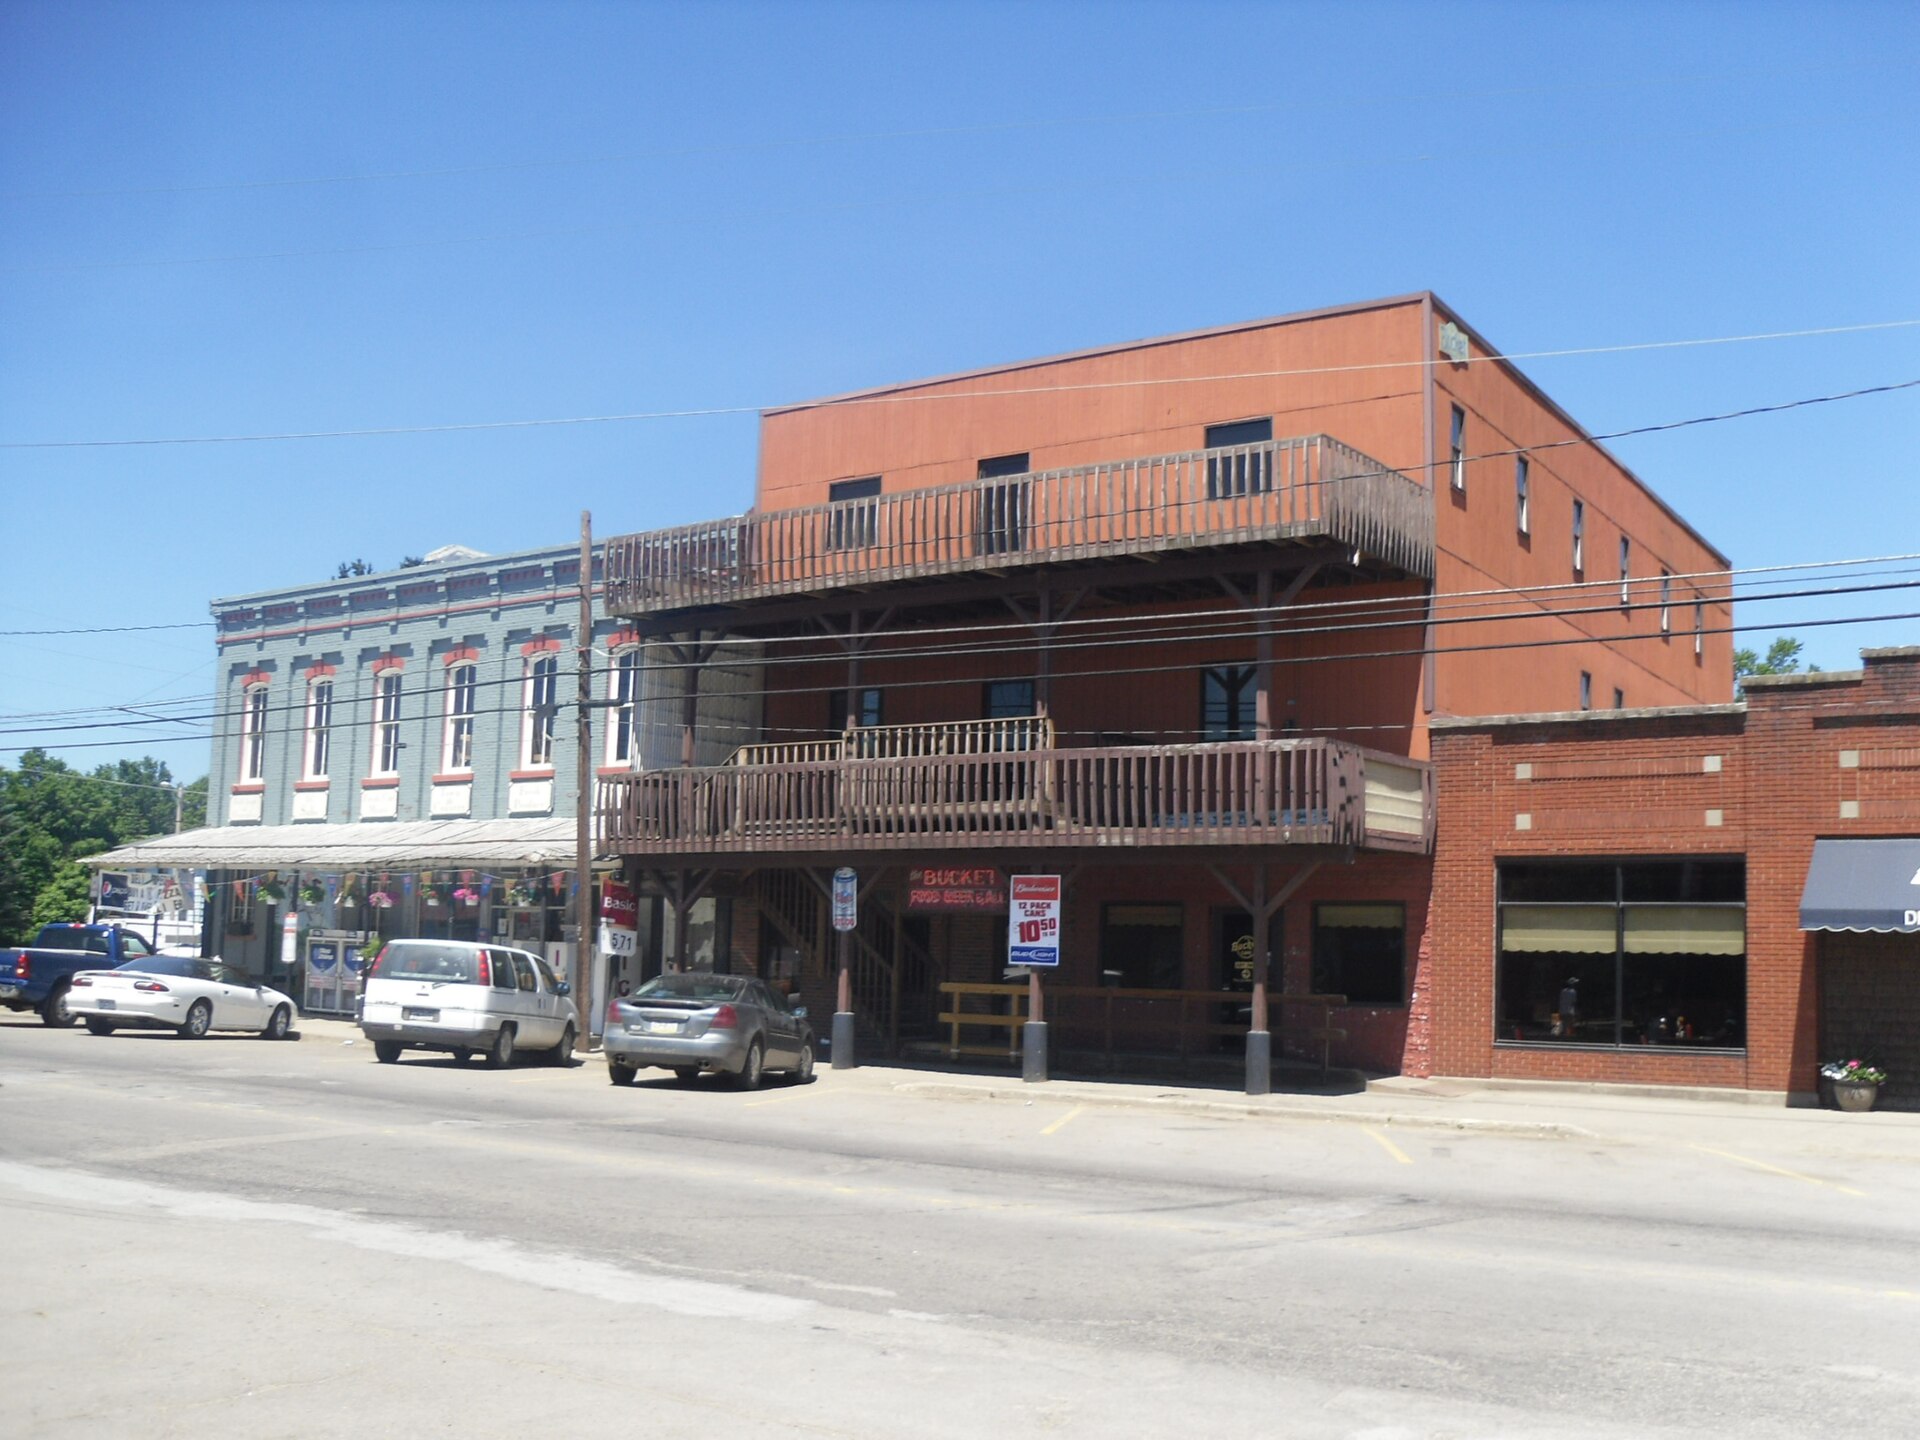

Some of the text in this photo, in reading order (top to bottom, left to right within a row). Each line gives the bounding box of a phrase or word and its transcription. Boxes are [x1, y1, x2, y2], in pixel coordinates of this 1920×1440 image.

[923, 869, 995, 886] BUCKET
[603, 896, 636, 912] Basic
[1018, 901, 1052, 910] 12 PACK
